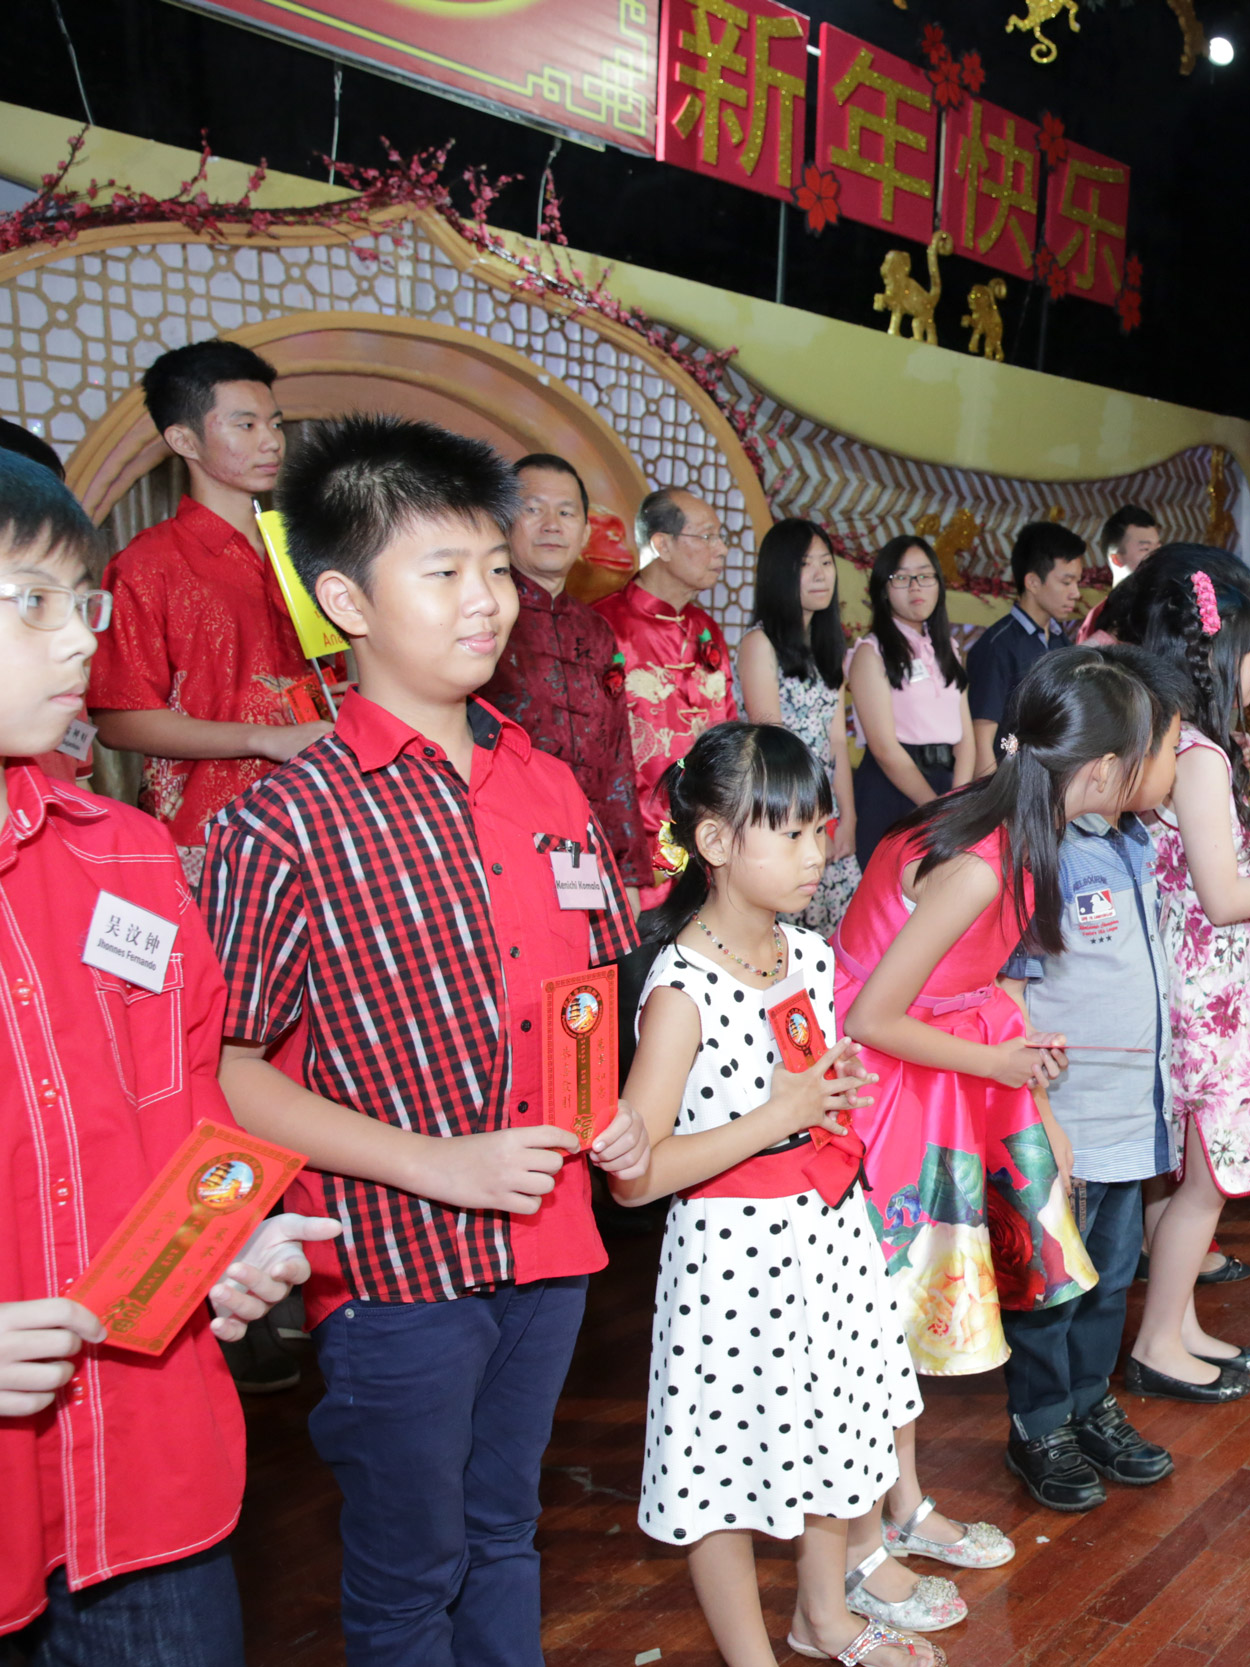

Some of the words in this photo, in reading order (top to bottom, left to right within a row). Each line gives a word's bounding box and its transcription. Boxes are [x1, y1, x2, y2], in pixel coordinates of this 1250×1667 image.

[672, 0, 1125, 291] 新年快乐
[556, 880, 577, 890] Kenichi
[105, 915, 160, 954] 吴汶钟
[126, 951, 156, 970] Fernando
